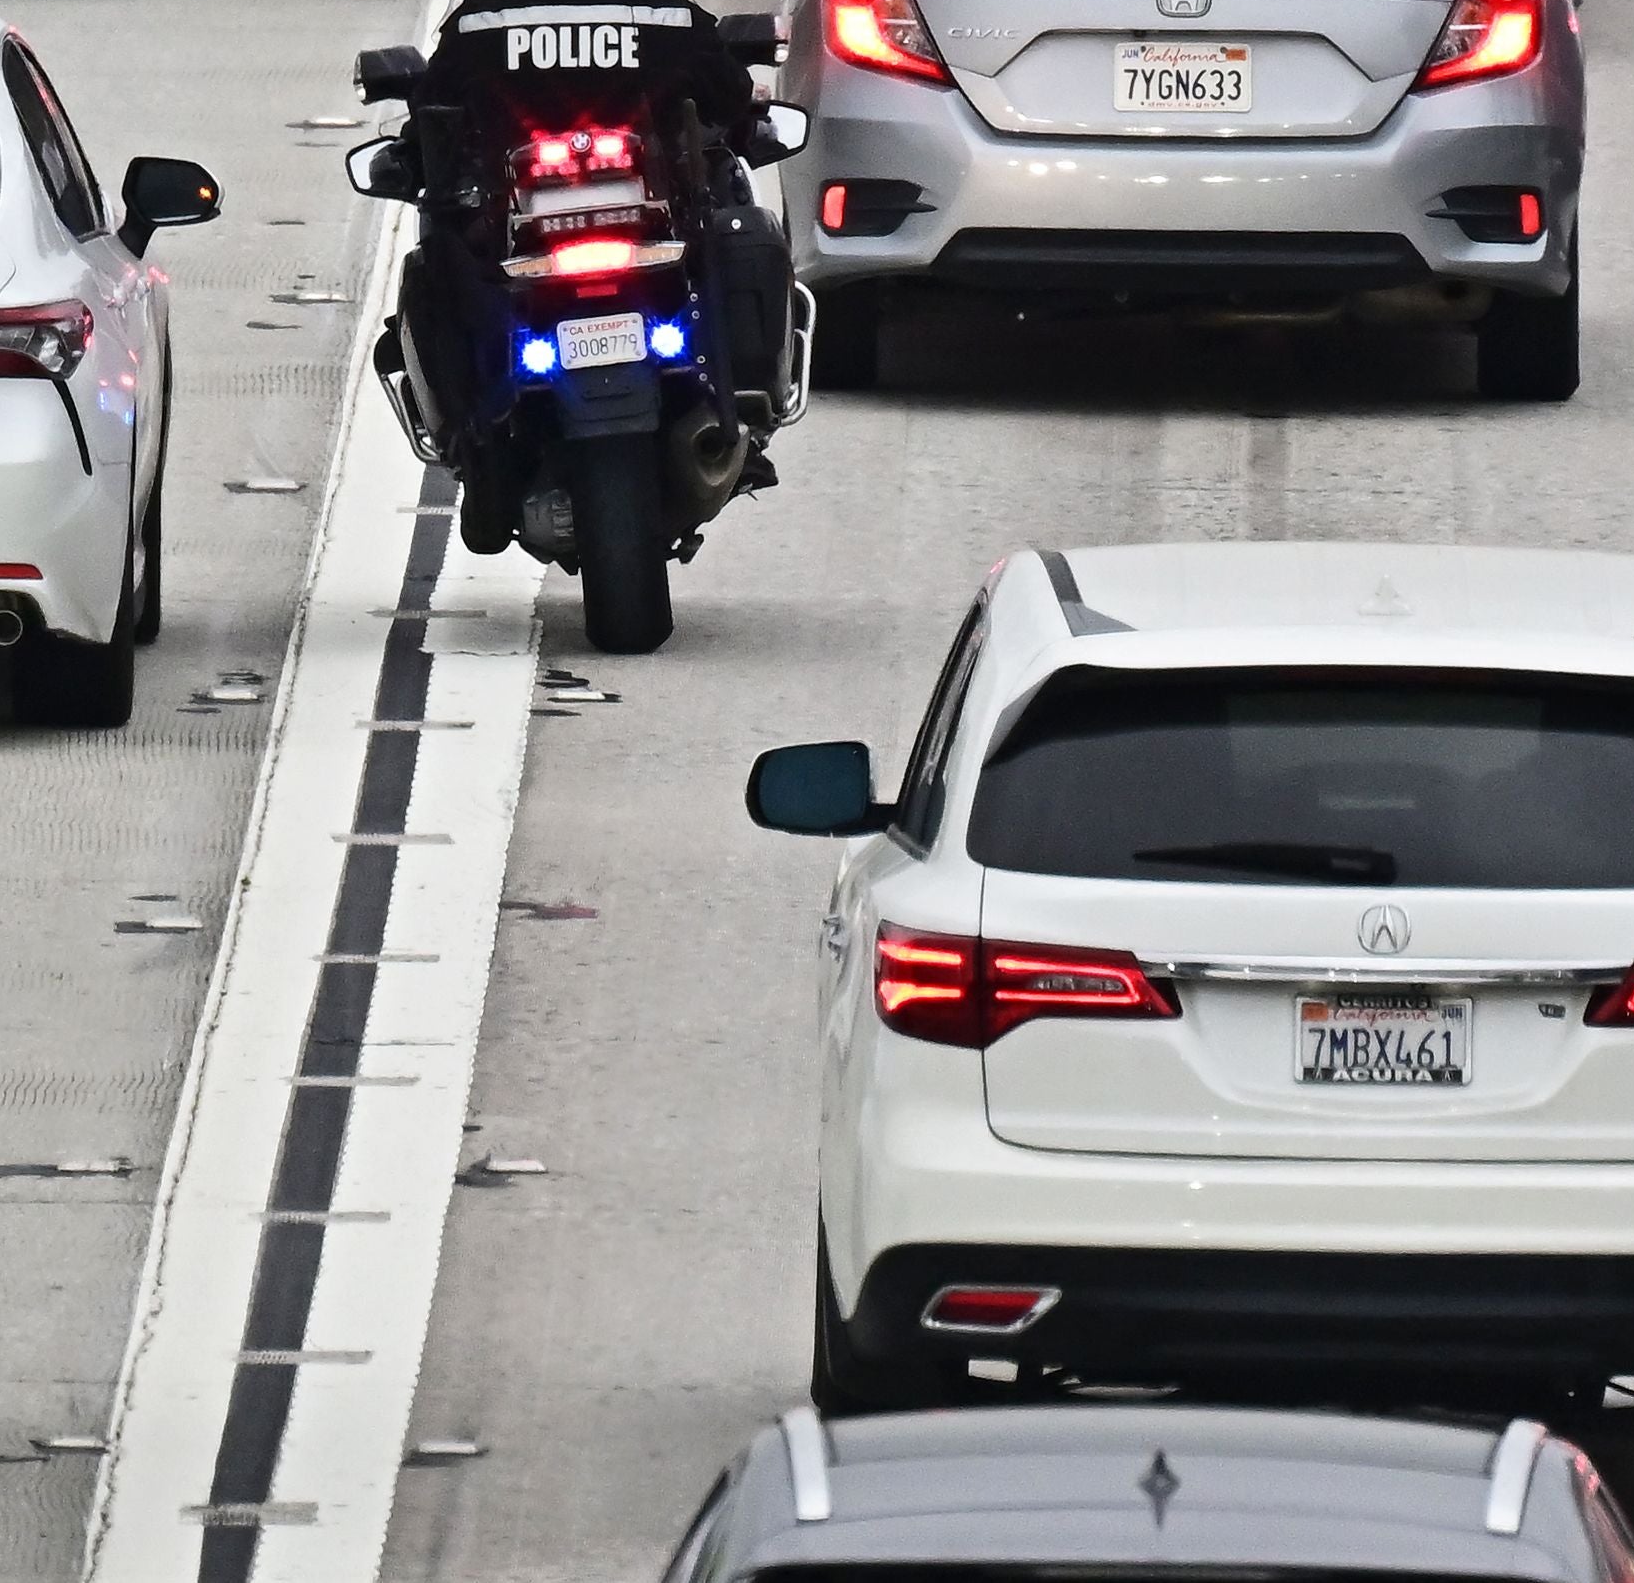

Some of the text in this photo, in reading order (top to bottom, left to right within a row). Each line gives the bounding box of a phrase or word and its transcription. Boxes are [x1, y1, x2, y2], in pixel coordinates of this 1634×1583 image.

[948, 27, 1020, 39] CIVIC
[507, 24, 639, 70] POLICE
[1122, 49, 1139, 58] JUN
[1143, 47, 1227, 67] California
[1124, 69, 1242, 101] 7YGN633
[569, 320, 630, 336] CA EXEMPT
[568, 334, 638, 359] 3008779
[1309, 1028, 1458, 1068] 7MBX461
[1332, 1068, 1434, 1082] ACURA
